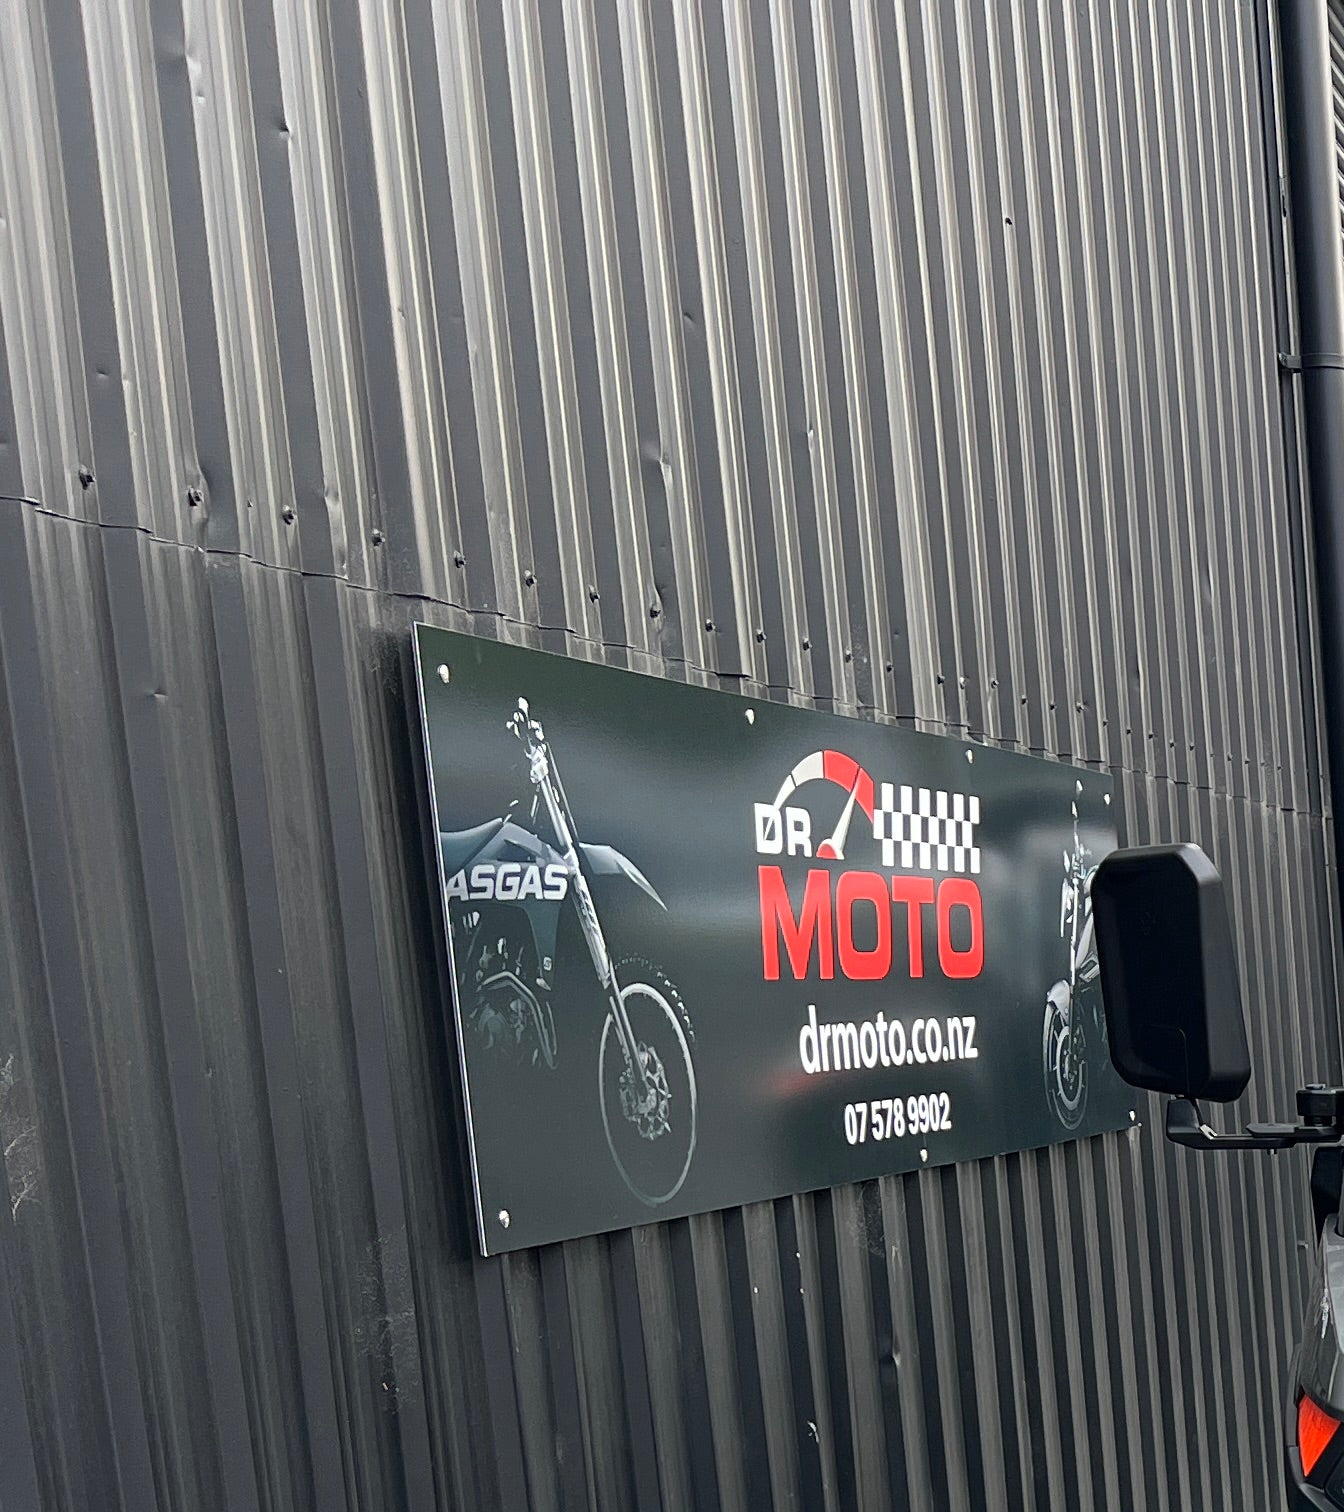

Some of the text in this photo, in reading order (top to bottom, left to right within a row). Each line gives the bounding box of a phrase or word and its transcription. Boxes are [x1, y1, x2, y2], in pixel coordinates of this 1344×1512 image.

[754, 803, 812, 857] DR
[758, 865, 984, 980] MOTO
[800, 1004, 978, 1074] drmoto.co.nz
[844, 1092, 952, 1145] 07 578 9902
